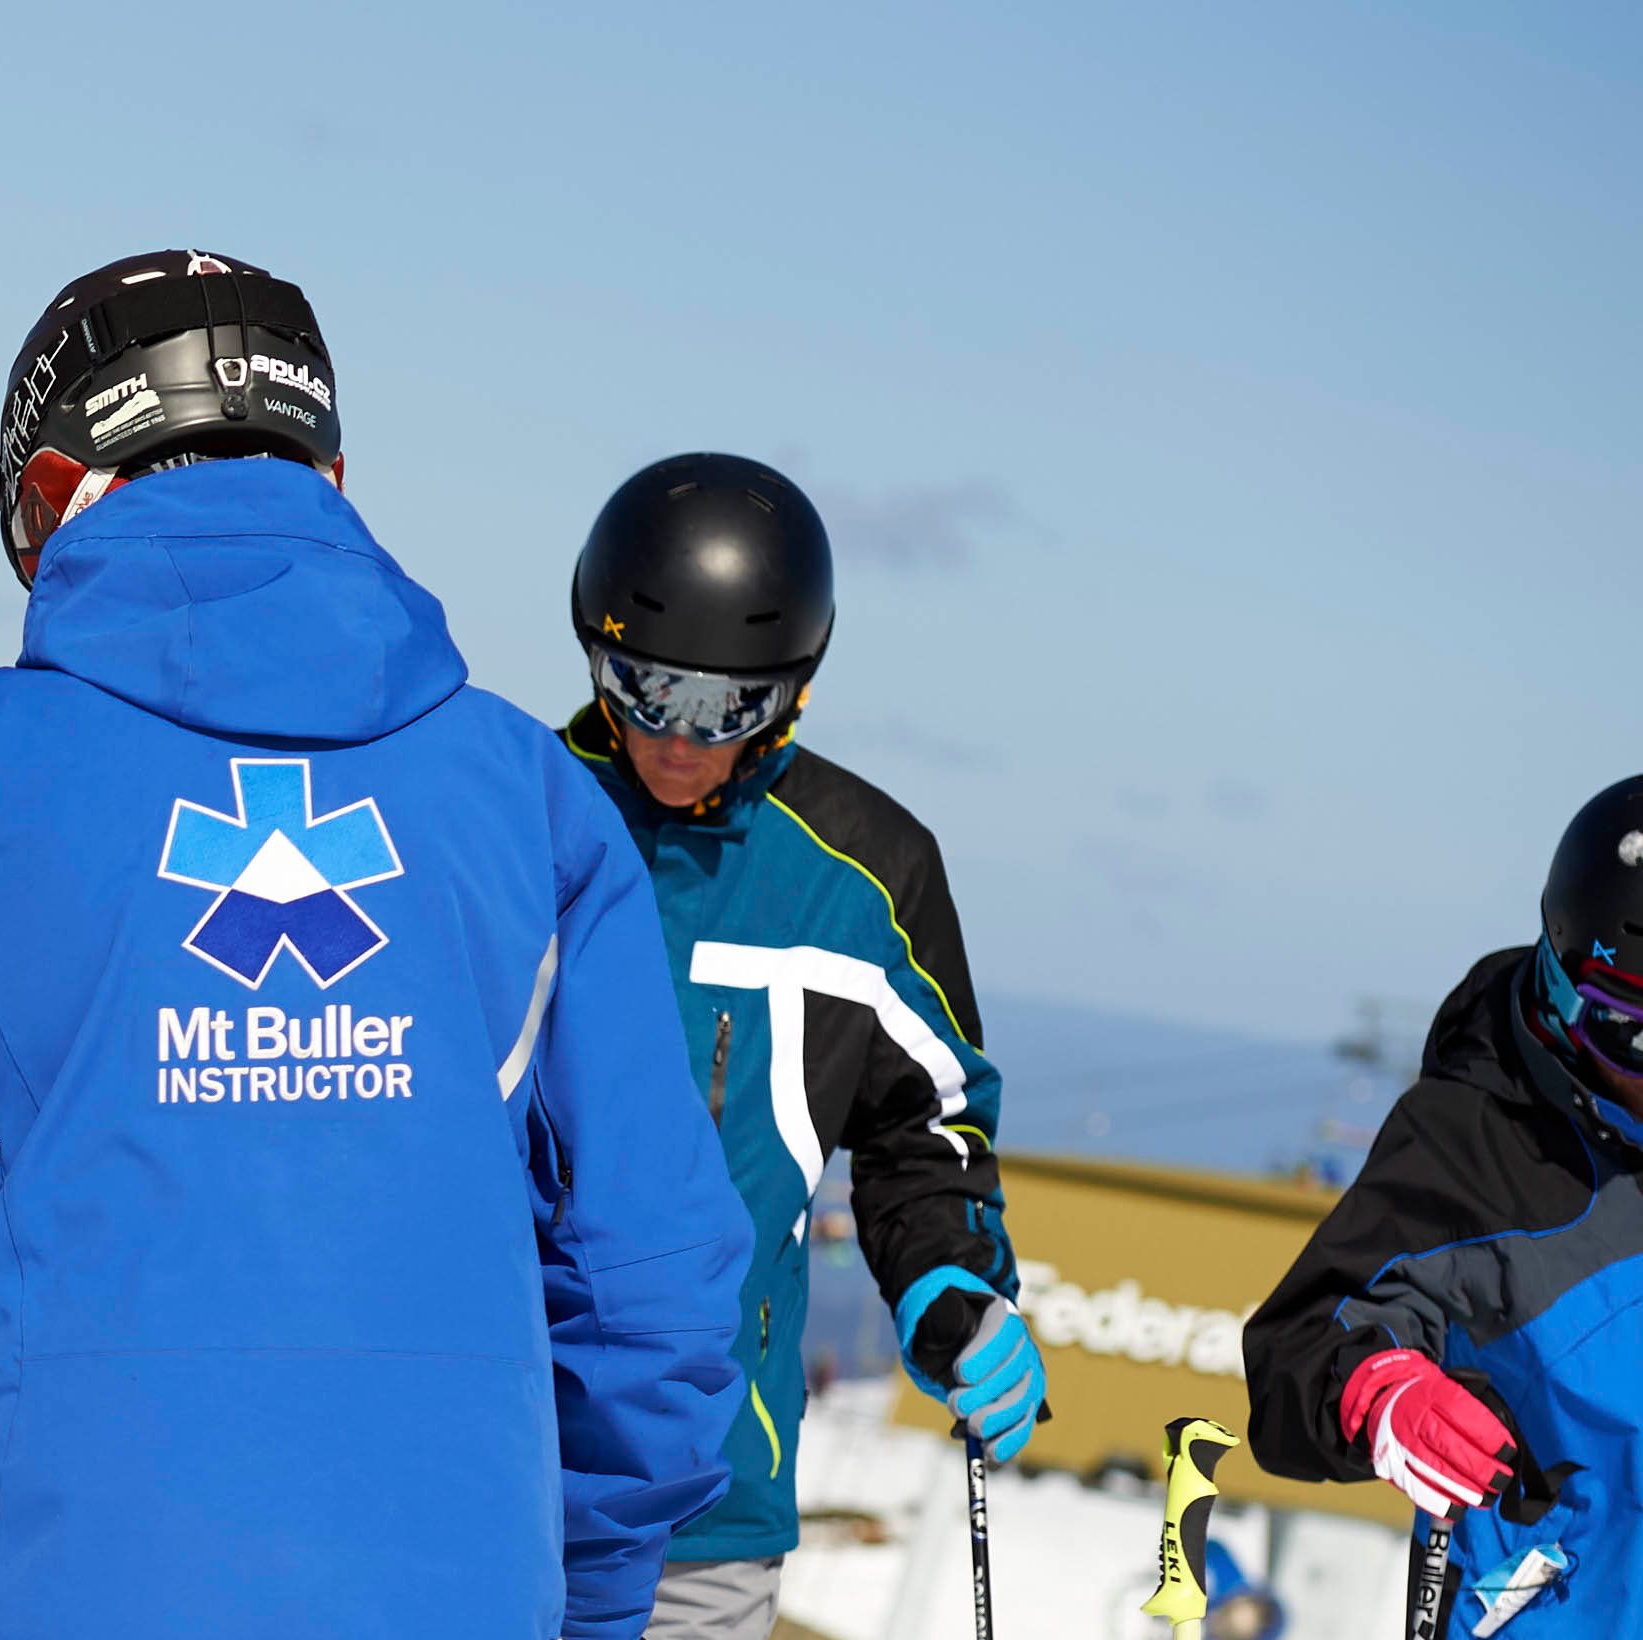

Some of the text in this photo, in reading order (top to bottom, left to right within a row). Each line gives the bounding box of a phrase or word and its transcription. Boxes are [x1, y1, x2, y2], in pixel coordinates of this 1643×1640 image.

[85, 373, 148, 417] SMITH
[264, 398, 317, 429] VANTAGE
[158, 1004, 413, 1062] Mt Buller
[158, 1064, 413, 1104] INSTRUCTOR
[1015, 1258, 1261, 1381] Federa
[1165, 1520, 1182, 1584] LEKI
[1416, 1527, 1451, 1622] Buller
